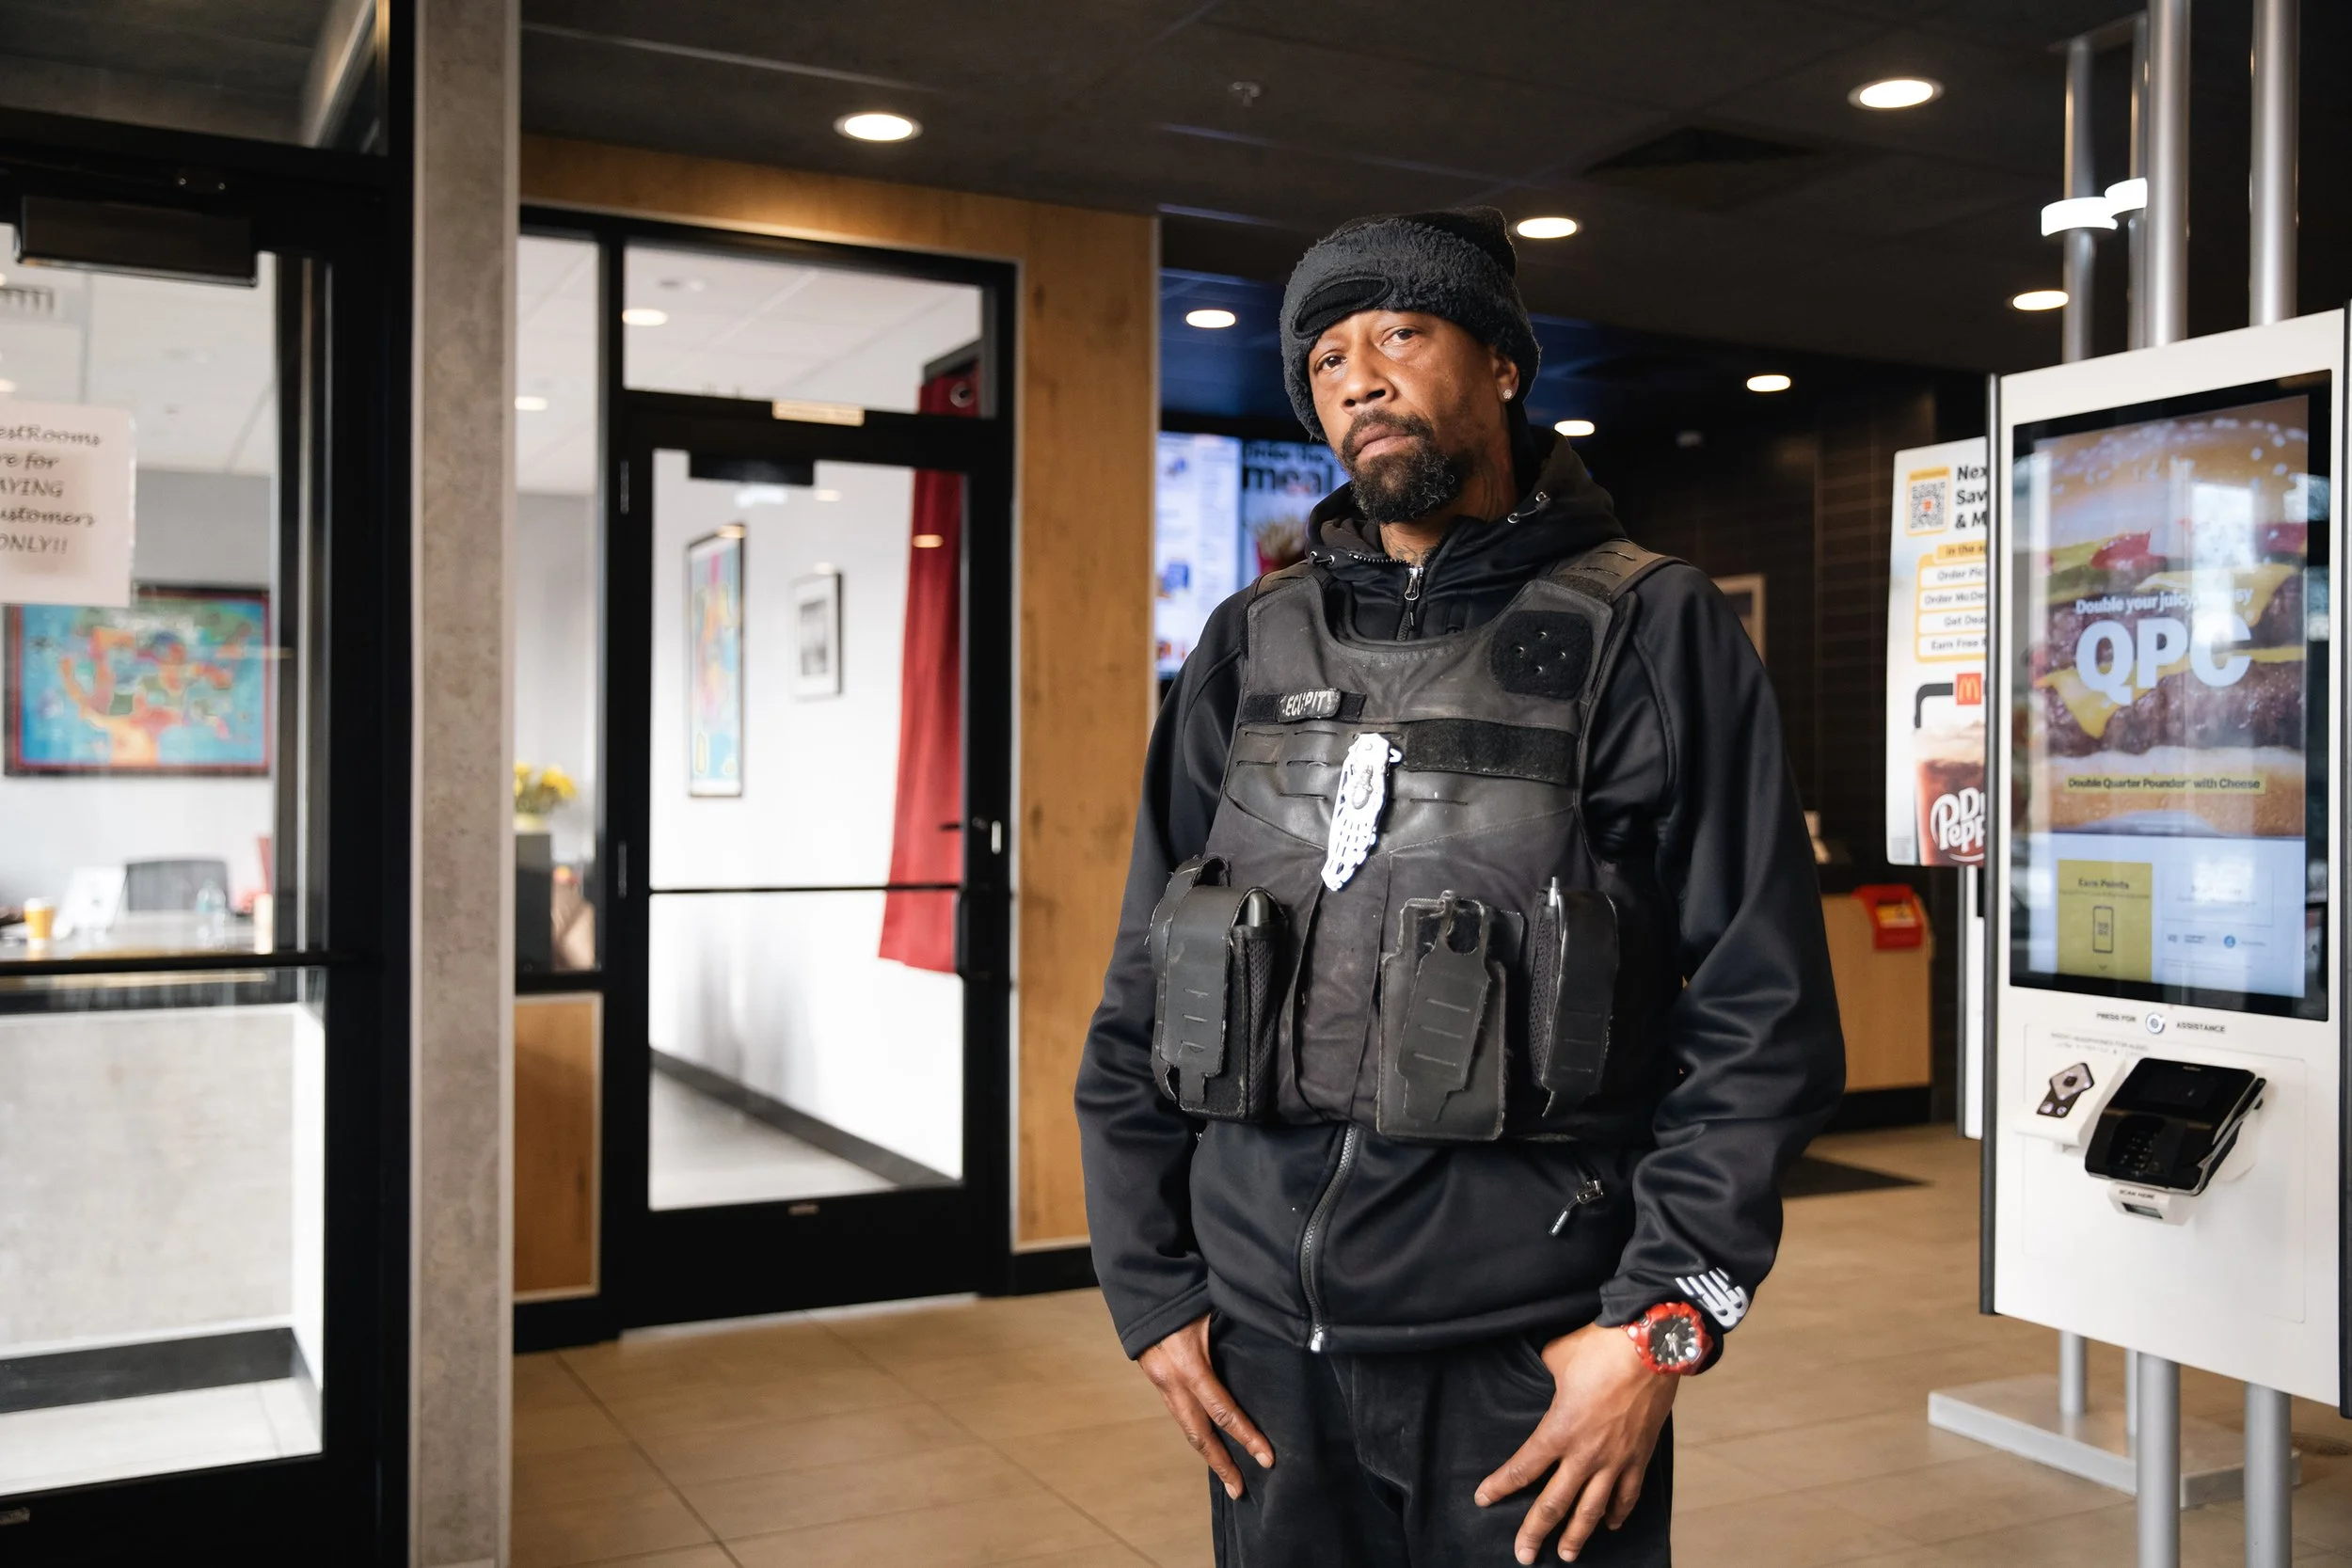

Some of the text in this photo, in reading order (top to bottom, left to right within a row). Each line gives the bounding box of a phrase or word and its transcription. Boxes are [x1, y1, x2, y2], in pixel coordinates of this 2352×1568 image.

[24, 451, 59, 471] for
[1956, 514, 1966, 528] &
[2075, 597, 2122, 615] Double
[2126, 595, 2158, 615] your
[2075, 616, 2251, 706] QPC
[2069, 778, 2101, 789] Double
[2103, 778, 2141, 789] Quarter
[2193, 778, 2217, 789] with
[2218, 779, 2261, 789] Cheese
